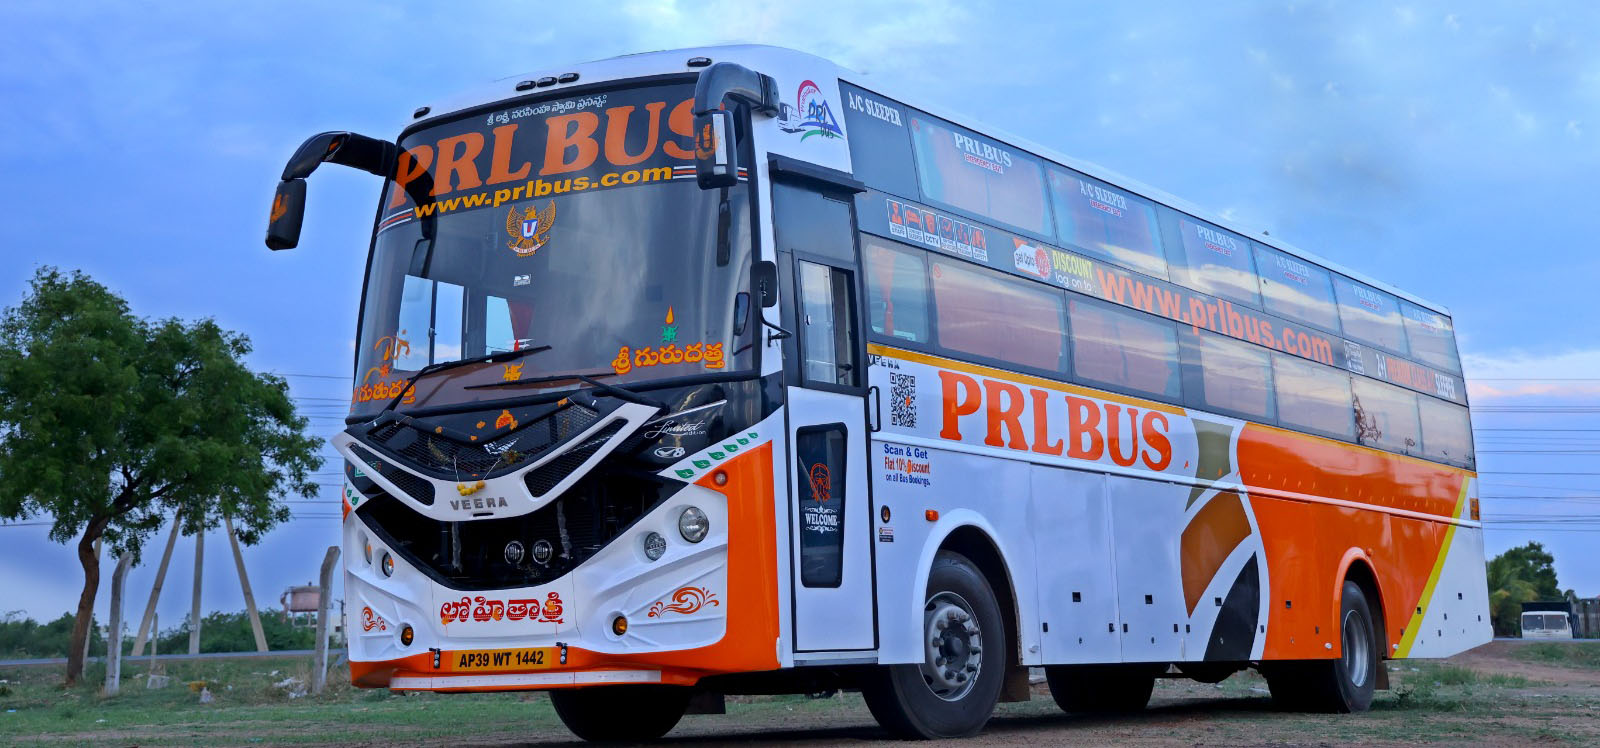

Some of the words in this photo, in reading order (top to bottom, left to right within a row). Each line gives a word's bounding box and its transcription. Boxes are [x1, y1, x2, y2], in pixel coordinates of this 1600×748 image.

[865, 98, 902, 127] SLEEPER
[953, 131, 1012, 168] PRLBUS
[415, 165, 671, 218] www.prlbus.com
[1197, 225, 1237, 250] PRLBUS
[1052, 250, 1093, 280] DISCOUNT
[1054, 271, 1069, 289] log
[1071, 278, 1082, 289] on
[1096, 268, 1334, 366] www.prlbus.com
[611, 345, 632, 376] శ్రీ
[634, 342, 725, 369] గురుదత్త
[938, 369, 1172, 472] PRLBUS
[884, 443, 904, 456] Scan
[906, 446, 912, 457] &
[914, 447, 928, 459] Get
[884, 456, 895, 471] Flat
[450, 496, 508, 511] VEERA
[805, 512, 838, 526] WELCOME
[459, 652, 490, 668] AP39
[493, 651, 512, 667] WT
[515, 650, 544, 666] 1442
